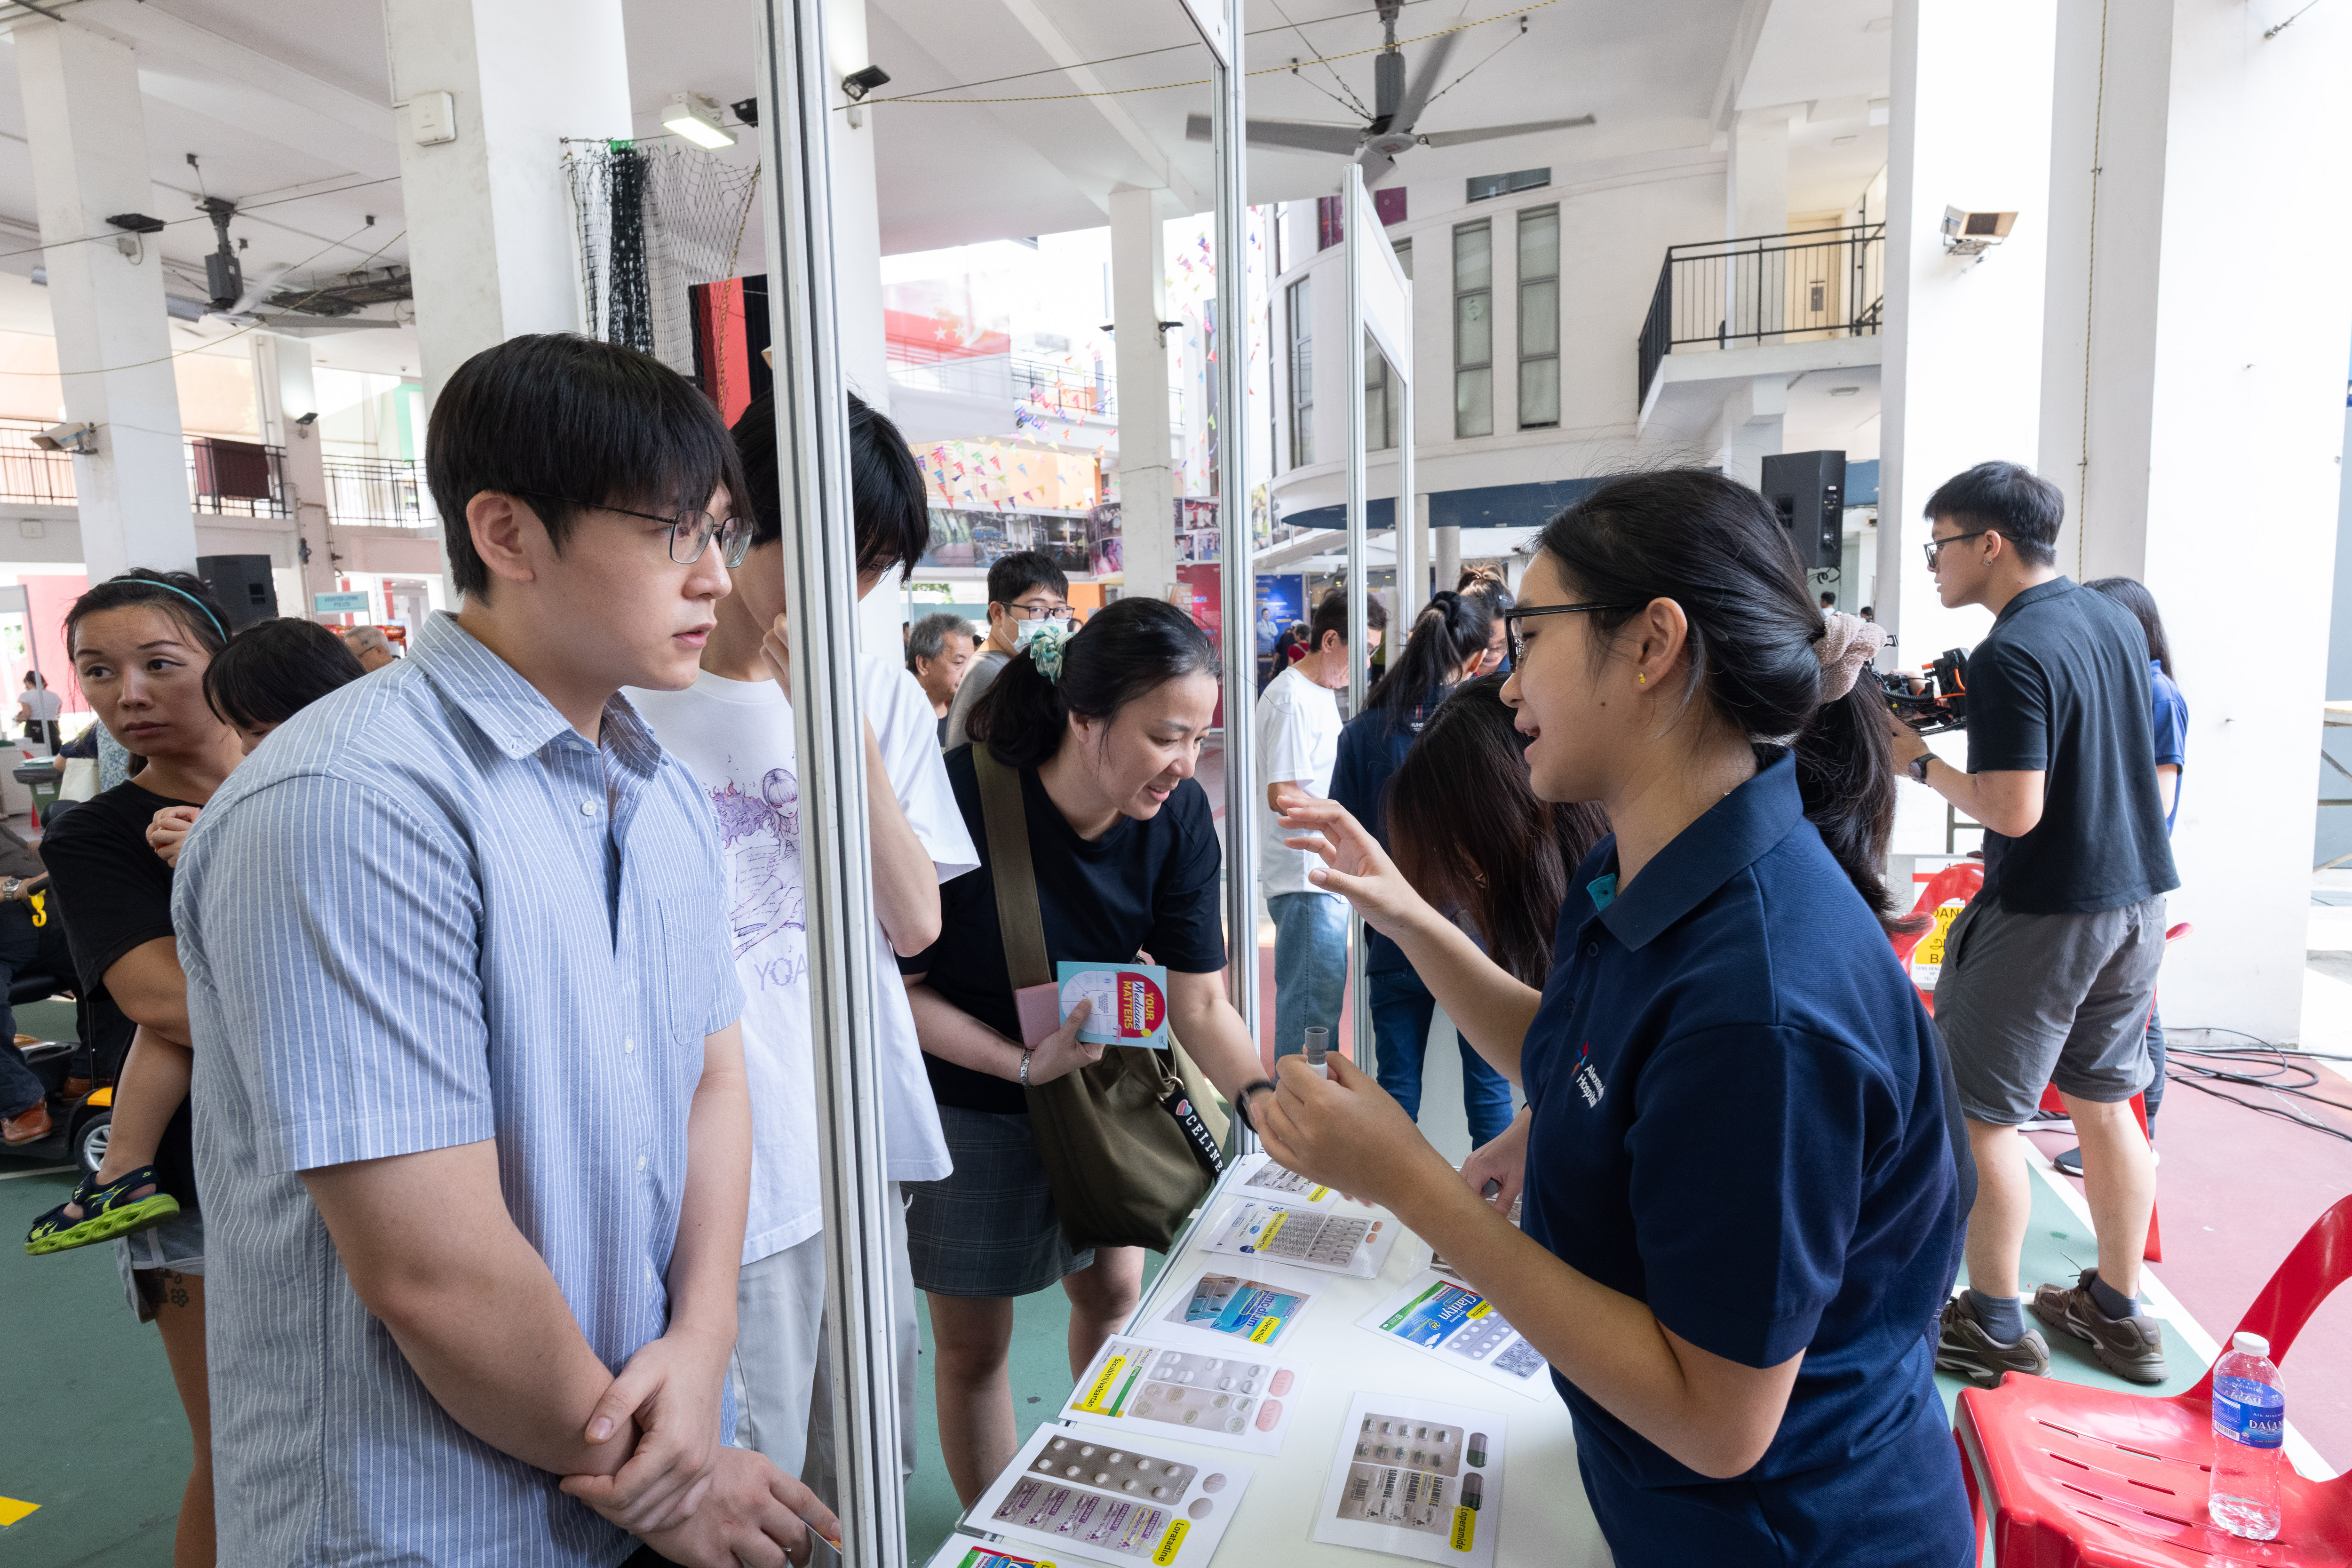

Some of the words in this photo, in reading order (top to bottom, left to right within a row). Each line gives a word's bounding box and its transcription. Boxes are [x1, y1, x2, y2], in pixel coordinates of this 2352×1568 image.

[1930, 954, 1944, 963] B
[1122, 980, 1133, 1029] MATTERS
[1133, 981, 1145, 1030] Medicine
[1144, 992, 1154, 1020] YOUR
[1185, 1115, 1223, 1172] CELINE
[1308, 1186, 1327, 1202] operamide
[1270, 1213, 1284, 1227] Sacubitril
[1256, 1233, 1271, 1248] Valsartan
[1246, 1292, 1280, 1328] Imodium
[1286, 1299, 1301, 1317] Imodium
[1438, 1293, 1477, 1321] Clarityn
[1252, 1317, 1276, 1343] Loperamide
[1085, 1358, 1121, 1407] Sacubitril/valsartan
[1383, 1469, 1398, 1498] LORAMIDE
[1405, 1472, 1421, 1503] LORAMIDE
[1428, 1476, 1443, 1507] LORAMIDE
[1049, 1489, 1071, 1512] LORADINE
[1079, 1496, 1100, 1520] LORADINE
[1100, 1501, 1118, 1521] Loratadine
[1131, 1507, 1149, 1528] Loratadine
[1455, 1507, 1470, 1550] Loperamide
[1158, 1522, 1185, 1563] Loratadine
[984, 1556, 993, 1566] Cold
